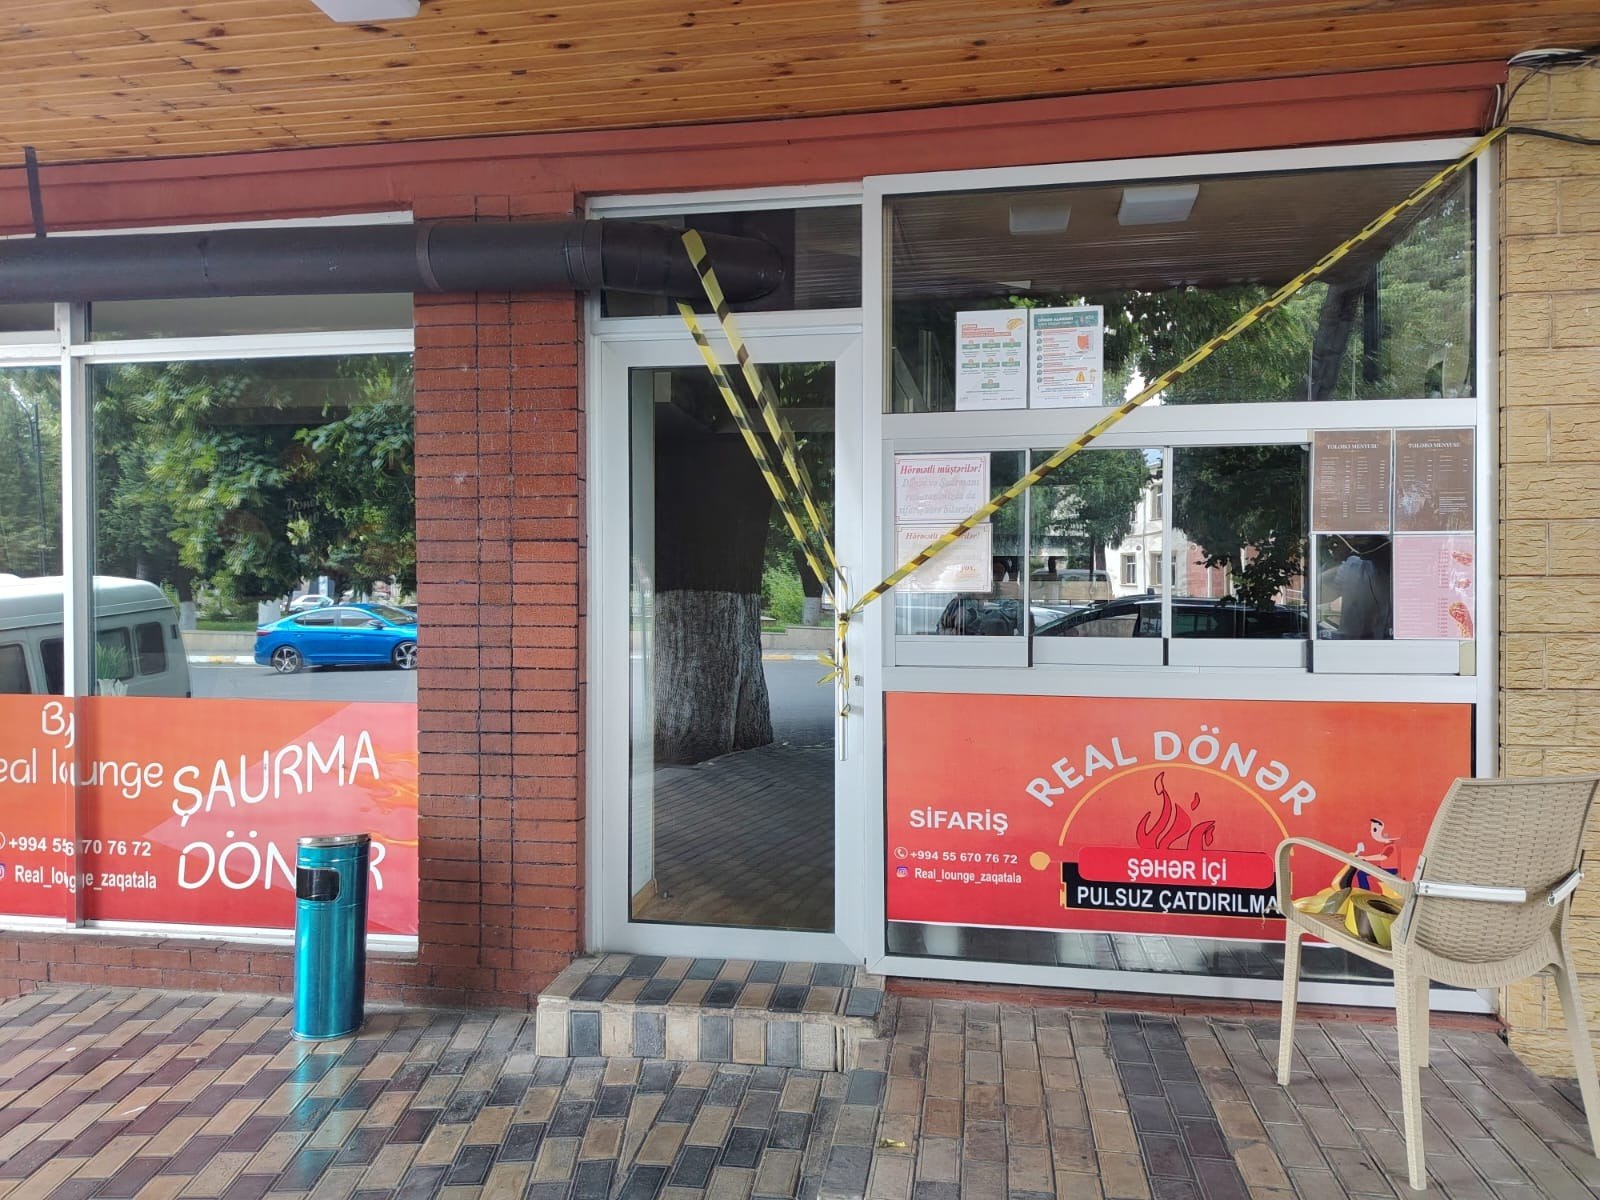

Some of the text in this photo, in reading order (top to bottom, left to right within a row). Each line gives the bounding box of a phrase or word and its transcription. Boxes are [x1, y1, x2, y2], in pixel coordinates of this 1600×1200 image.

[172, 730, 381, 828] ŞAURMA
[1025, 724, 1317, 816] REAL DÖNƏR
[909, 806, 1009, 836] SİFARİŞ
[8, 836, 47, 852] +994
[107, 840, 127, 856] 76
[132, 841, 152, 857] 72
[177, 830, 386, 891] DÖNR
[910, 850, 1018, 865] +994 55 670 76 72
[914, 867, 1022, 886] Real_lounge_zaqatala
[1127, 857, 1227, 886] ŞƏHƏR İÇİ
[1077, 886, 1281, 914] PULSUZ ÇATDIRILMA
